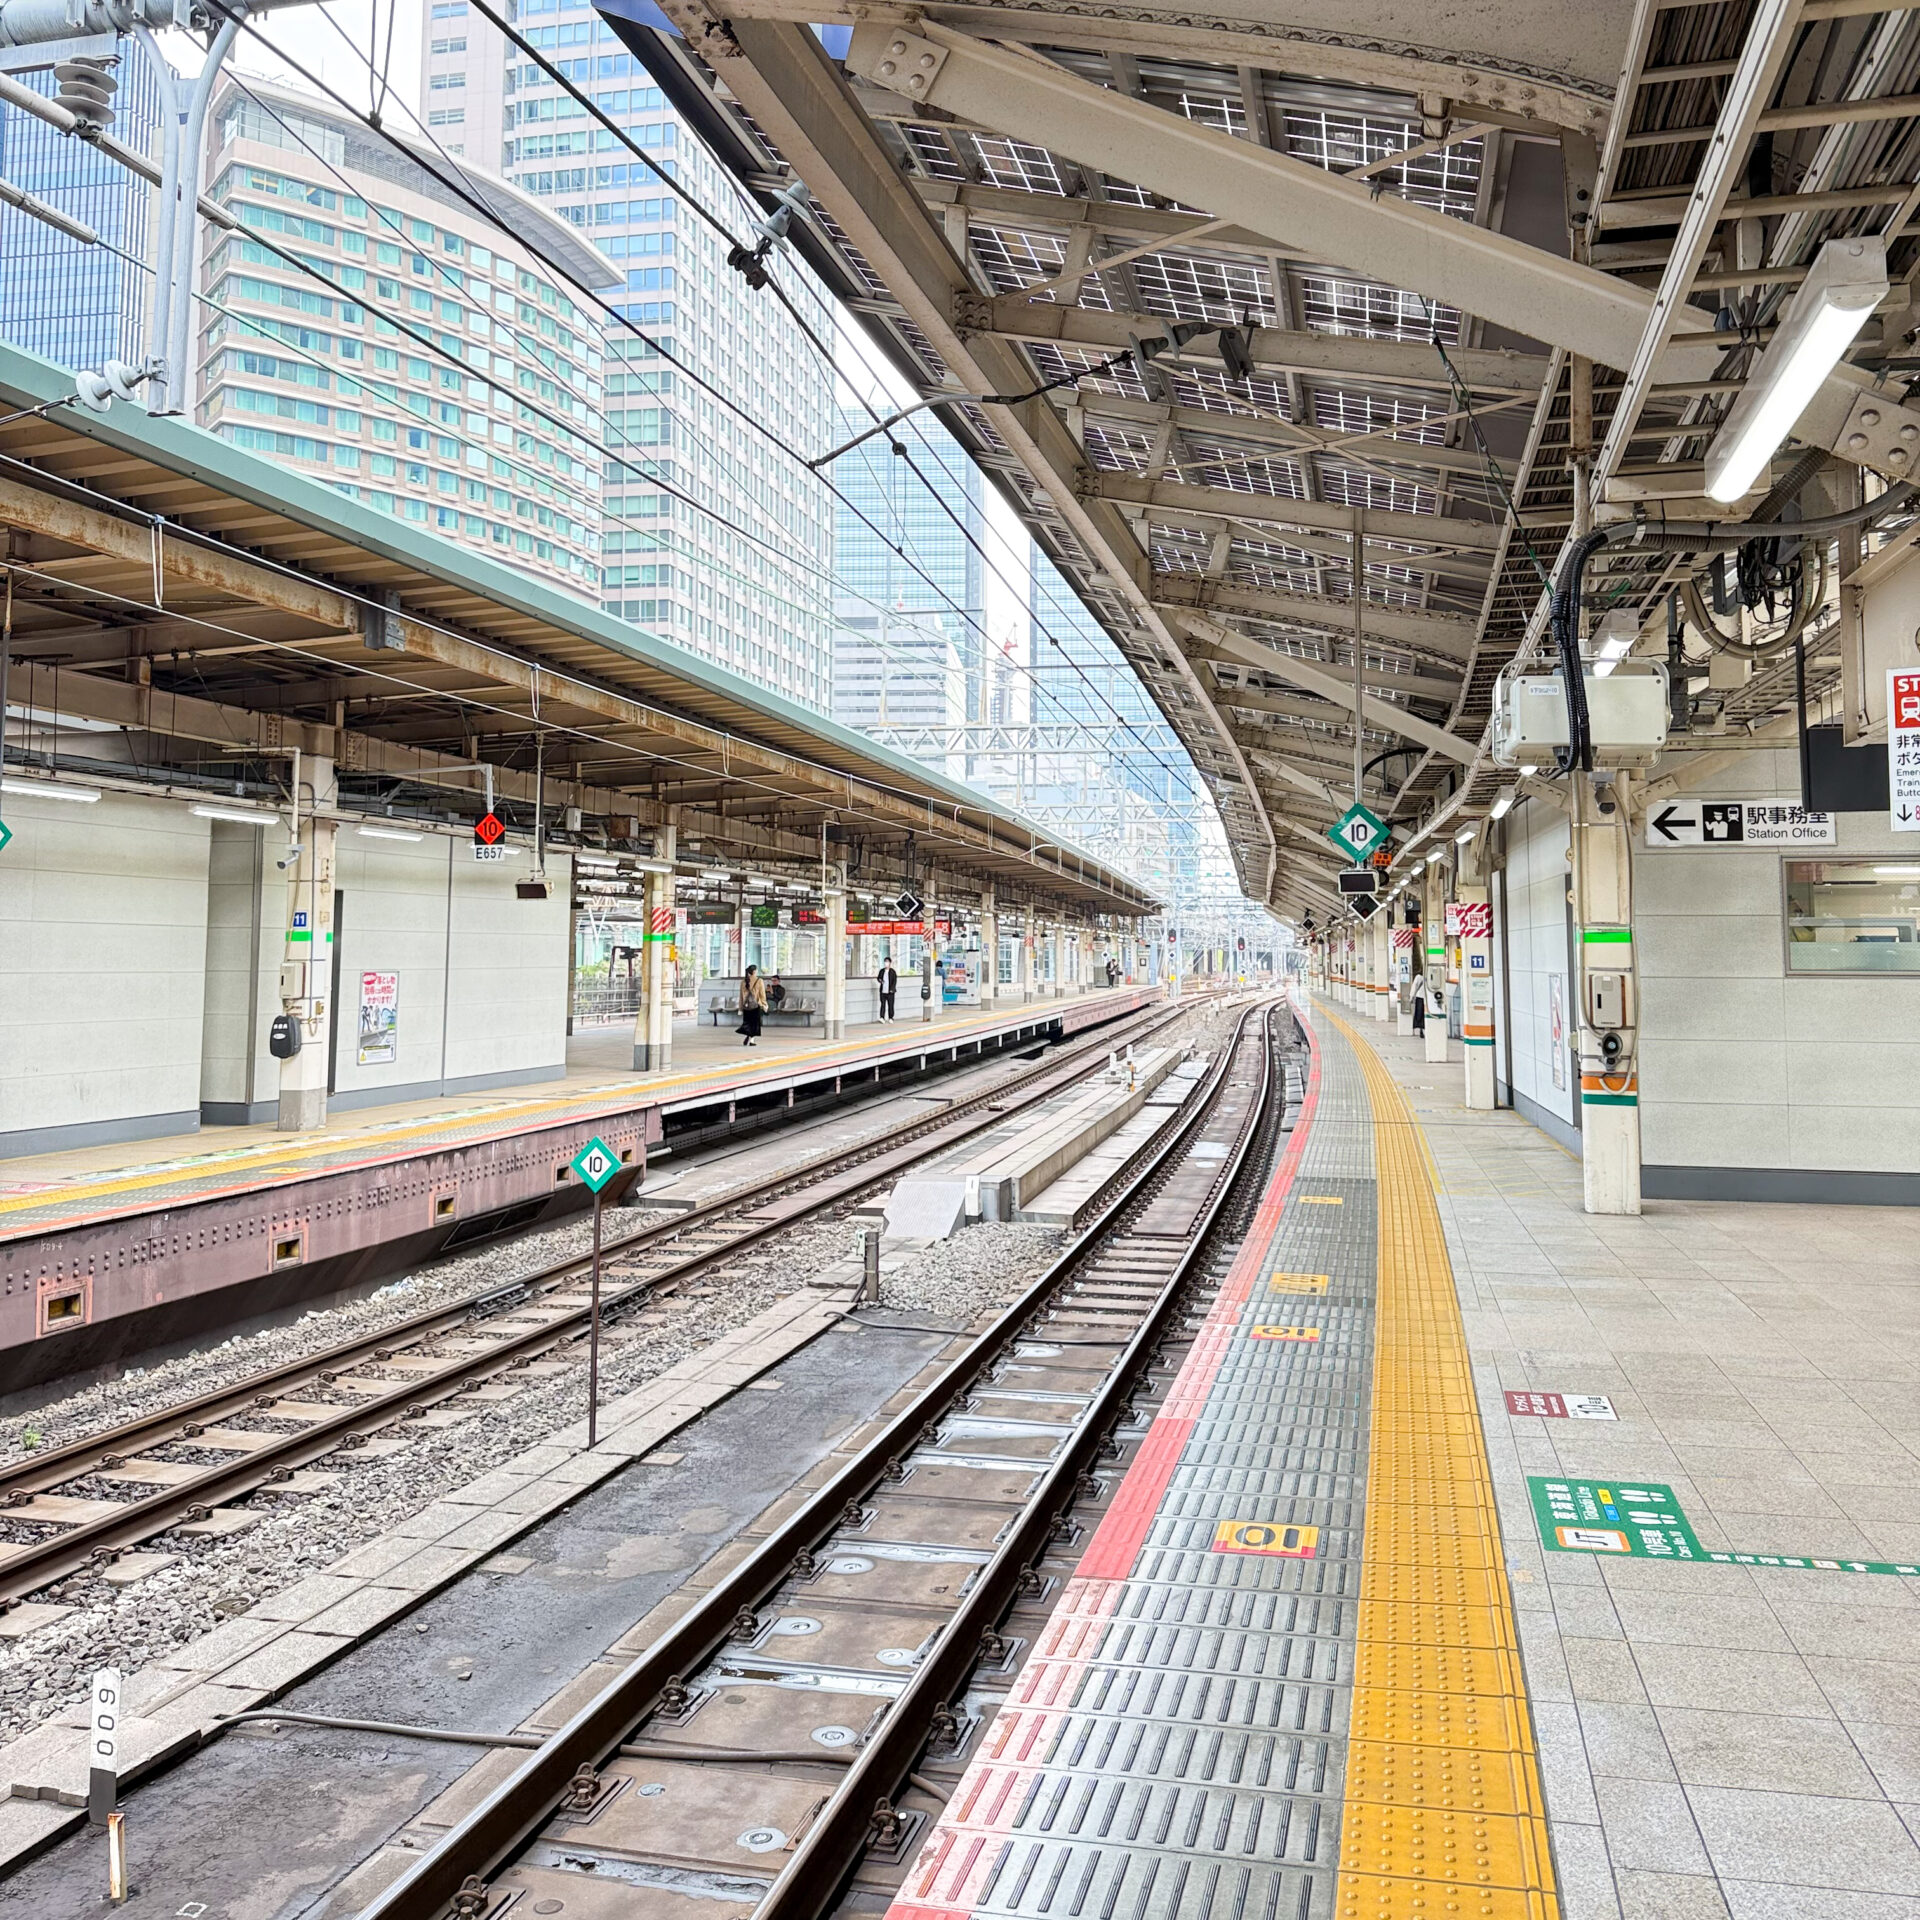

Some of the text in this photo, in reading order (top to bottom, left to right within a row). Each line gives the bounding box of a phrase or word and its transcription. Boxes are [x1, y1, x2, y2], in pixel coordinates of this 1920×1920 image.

[1896, 768, 1920, 777] Emer
[1746, 806, 1830, 825] 駅事務室
[482, 821, 498, 837] 10
[1350, 823, 1368, 843] 10
[1747, 827, 1828, 839] Station Office
[475, 847, 503, 860] E657
[1407, 901, 1413, 909] 9
[294, 913, 306, 926] 11
[1472, 957, 1483, 967] 11
[588, 1156, 603, 1173] 10
[1574, 1531, 1609, 1546] JT
[1639, 1528, 1674, 1555] 10号車
[96, 1688, 116, 1756] 009
